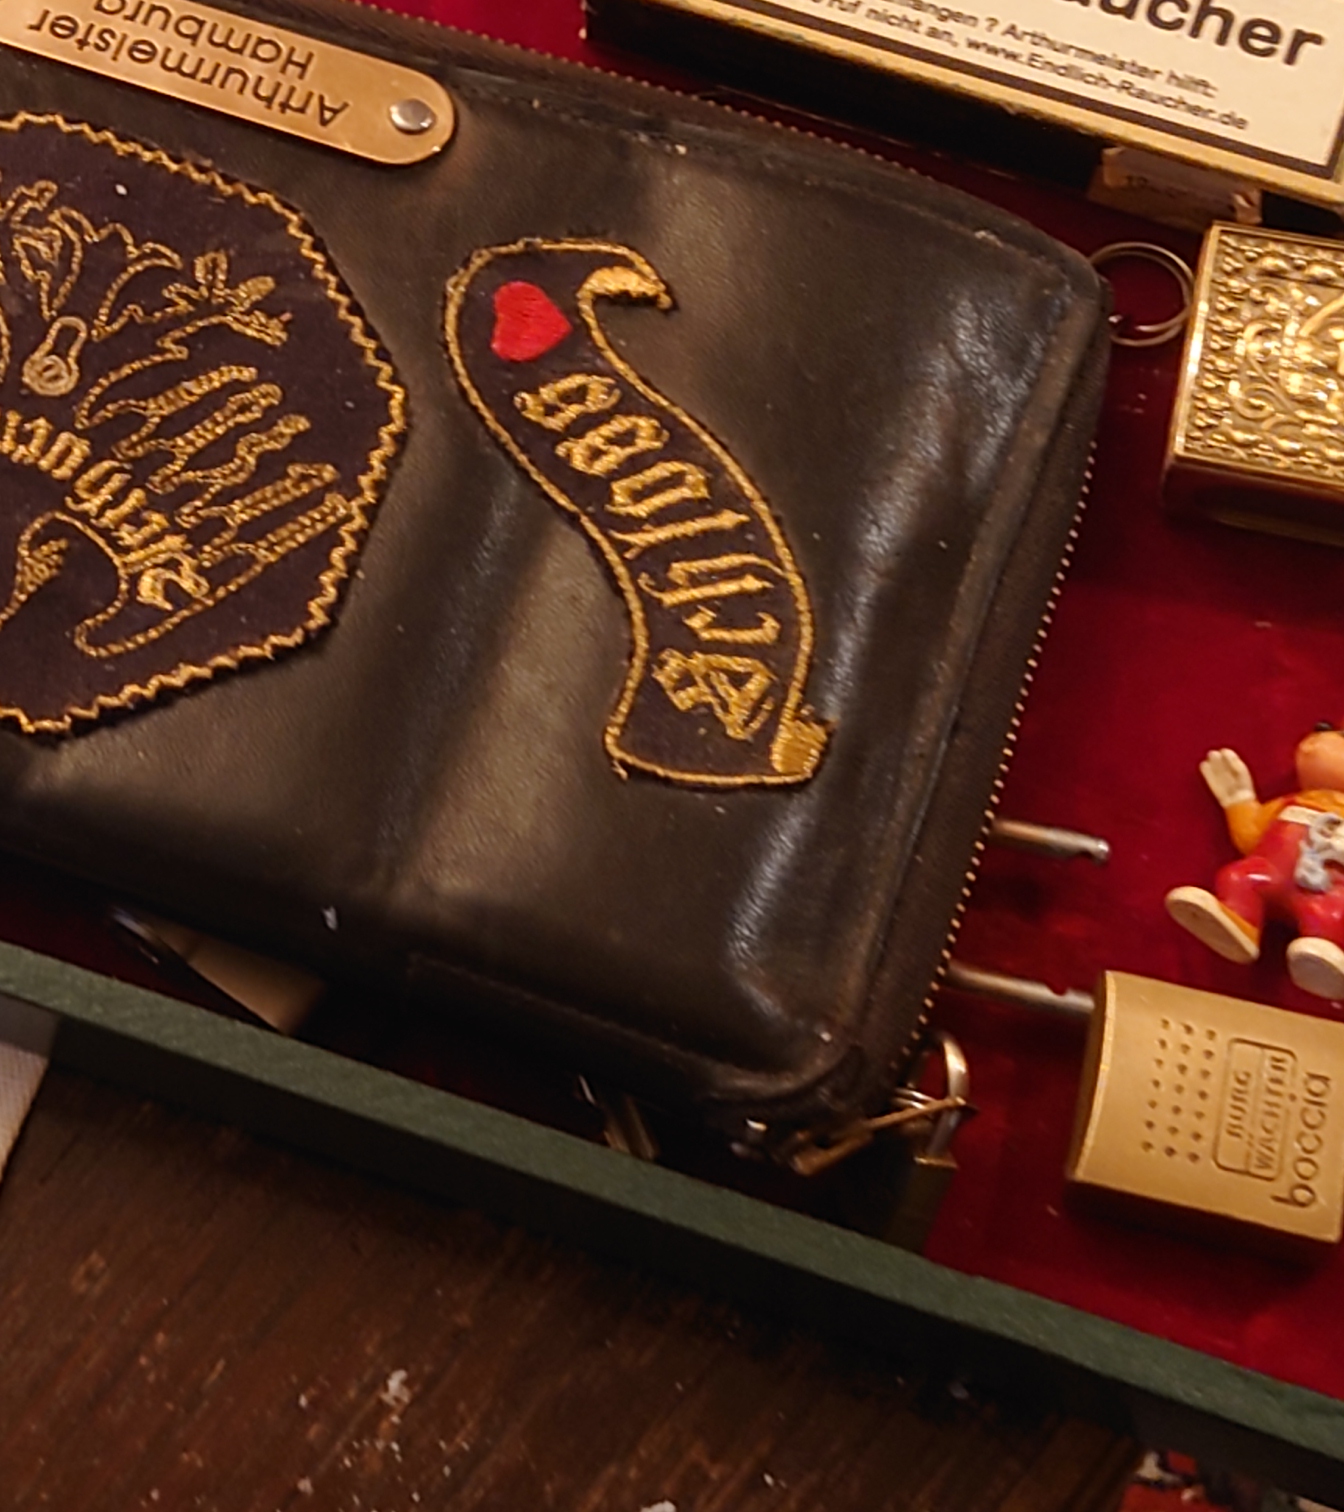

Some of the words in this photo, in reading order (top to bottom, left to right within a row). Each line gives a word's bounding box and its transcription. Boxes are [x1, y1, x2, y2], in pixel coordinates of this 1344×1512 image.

[27, 9, 349, 131] Arthurmeister
[864, 1, 922, 37] nicht
[924, 21, 960, 49] an,
[966, 35, 1249, 133] www.Endlich-Raucher.de
[1002, 23, 1162, 83] Arthurmeister
[1226, 1064, 1251, 1143] BURG
[1275, 1070, 1334, 1209] boccia
